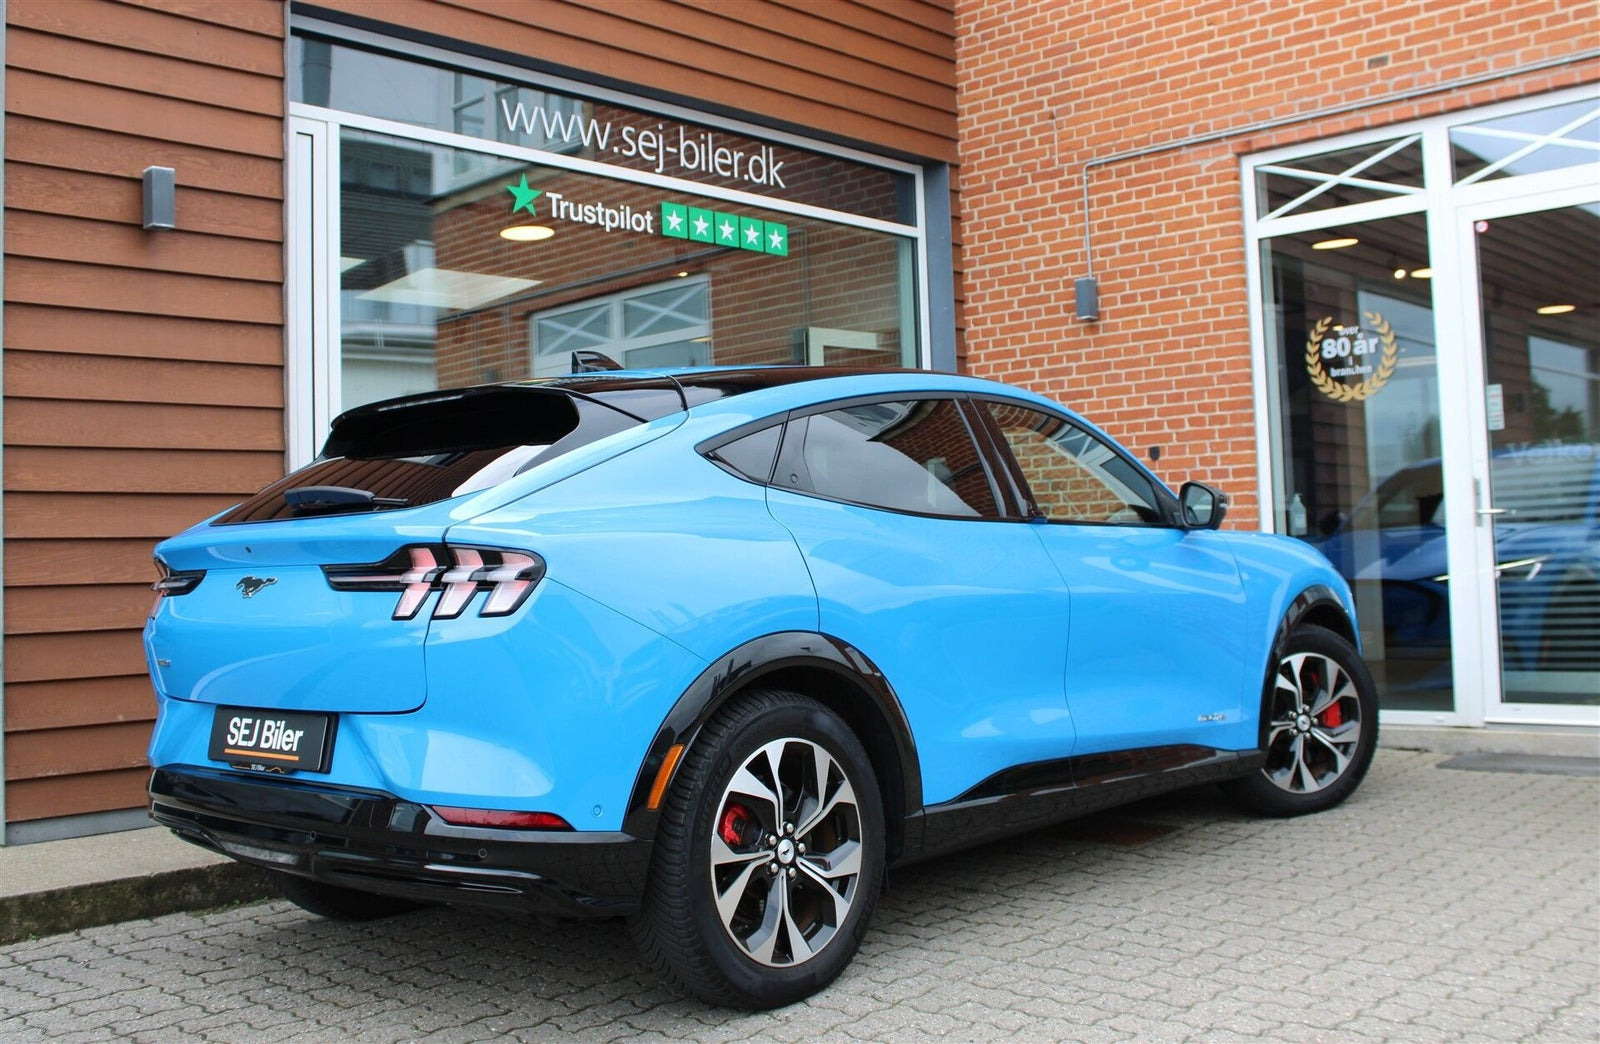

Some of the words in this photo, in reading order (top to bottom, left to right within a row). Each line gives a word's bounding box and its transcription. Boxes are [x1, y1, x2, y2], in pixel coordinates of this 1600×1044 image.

[501, 98, 786, 189] www.sej-biler.dk
[545, 191, 654, 234] Trustpilot
[1321, 336, 1351, 359] 80
[1352, 332, 1379, 355] år
[227, 716, 260, 747] SEJ
[259, 719, 304, 752] Biler
